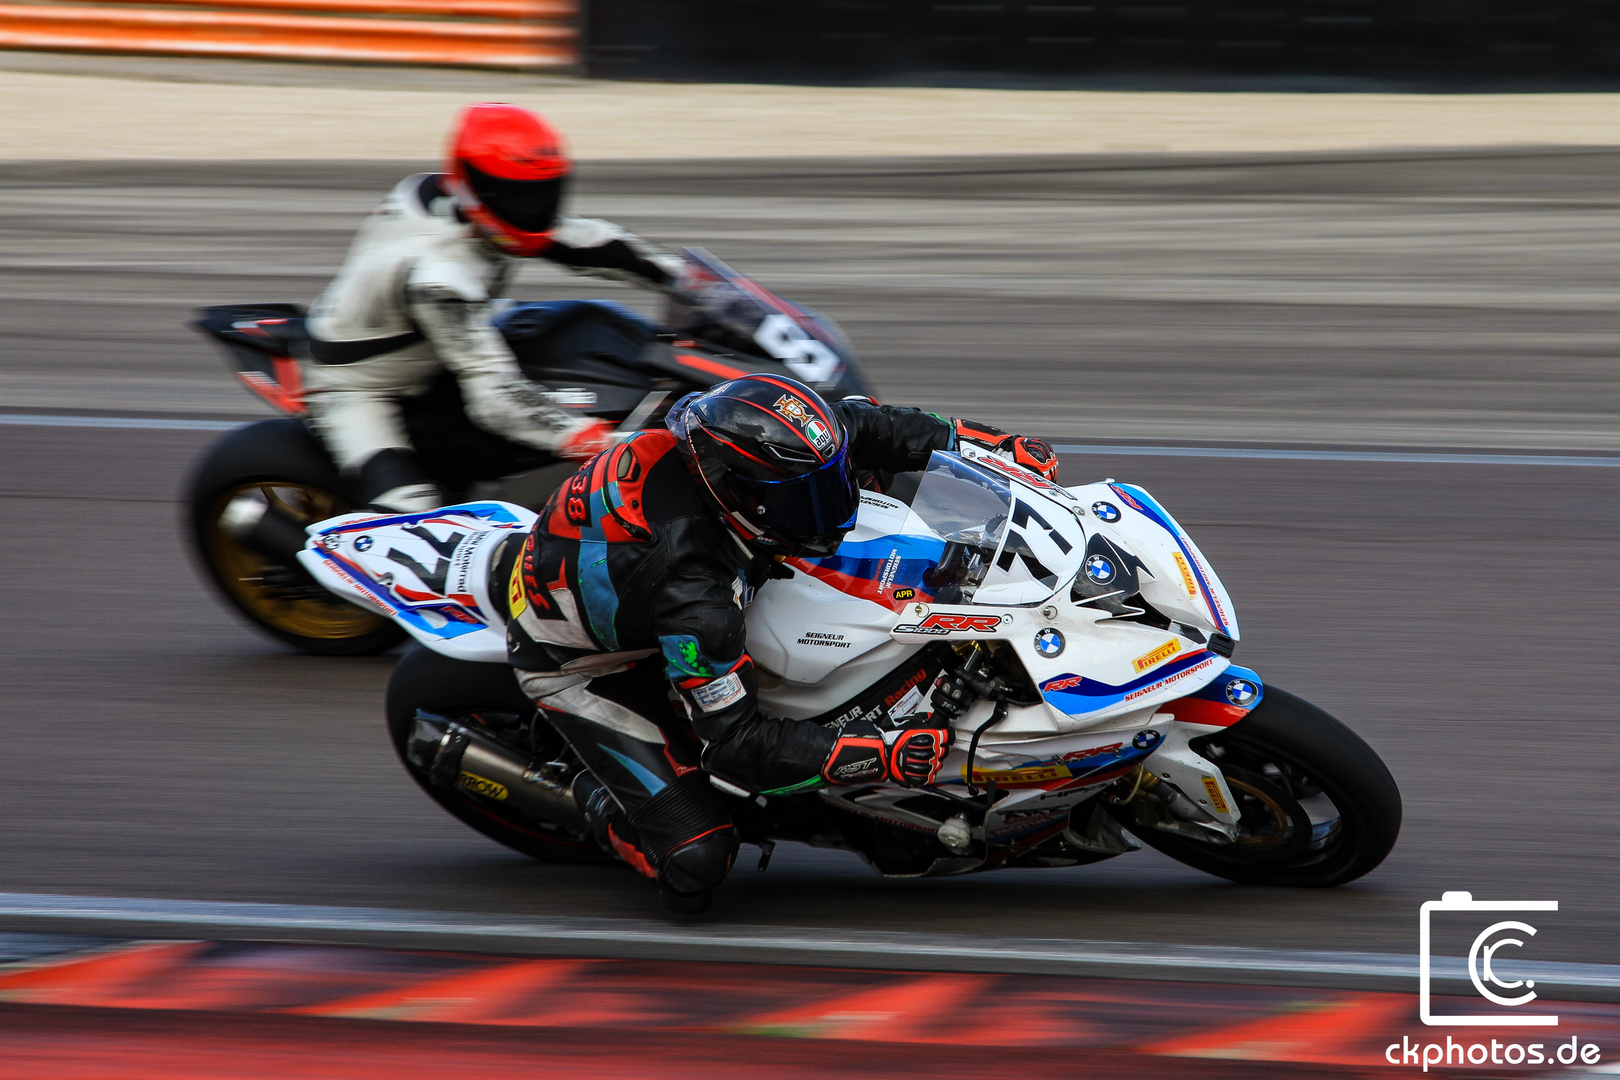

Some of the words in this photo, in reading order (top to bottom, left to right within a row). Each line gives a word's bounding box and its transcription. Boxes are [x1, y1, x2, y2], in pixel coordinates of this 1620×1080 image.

[995, 497, 1073, 592] 77
[386, 525, 467, 596] 77
[876, 548, 898, 595] MOTORSPORT
[885, 555, 902, 588] SEIGNEUR
[895, 589, 913, 599] APR
[805, 632, 844, 641] SEIGNEUR
[894, 625, 949, 635] S1000
[920, 614, 1000, 631] RR
[797, 638, 852, 649] MOTORSPORT
[1137, 642, 1176, 670] PIRELLI
[884, 668, 927, 707] Racing
[1043, 676, 1082, 693] RR
[1124, 682, 1163, 702] SEIGNEUR
[1164, 658, 1214, 685] MOTORSPORT
[834, 757, 878, 776] RST
[1205, 781, 1227, 810] PIRELLI
